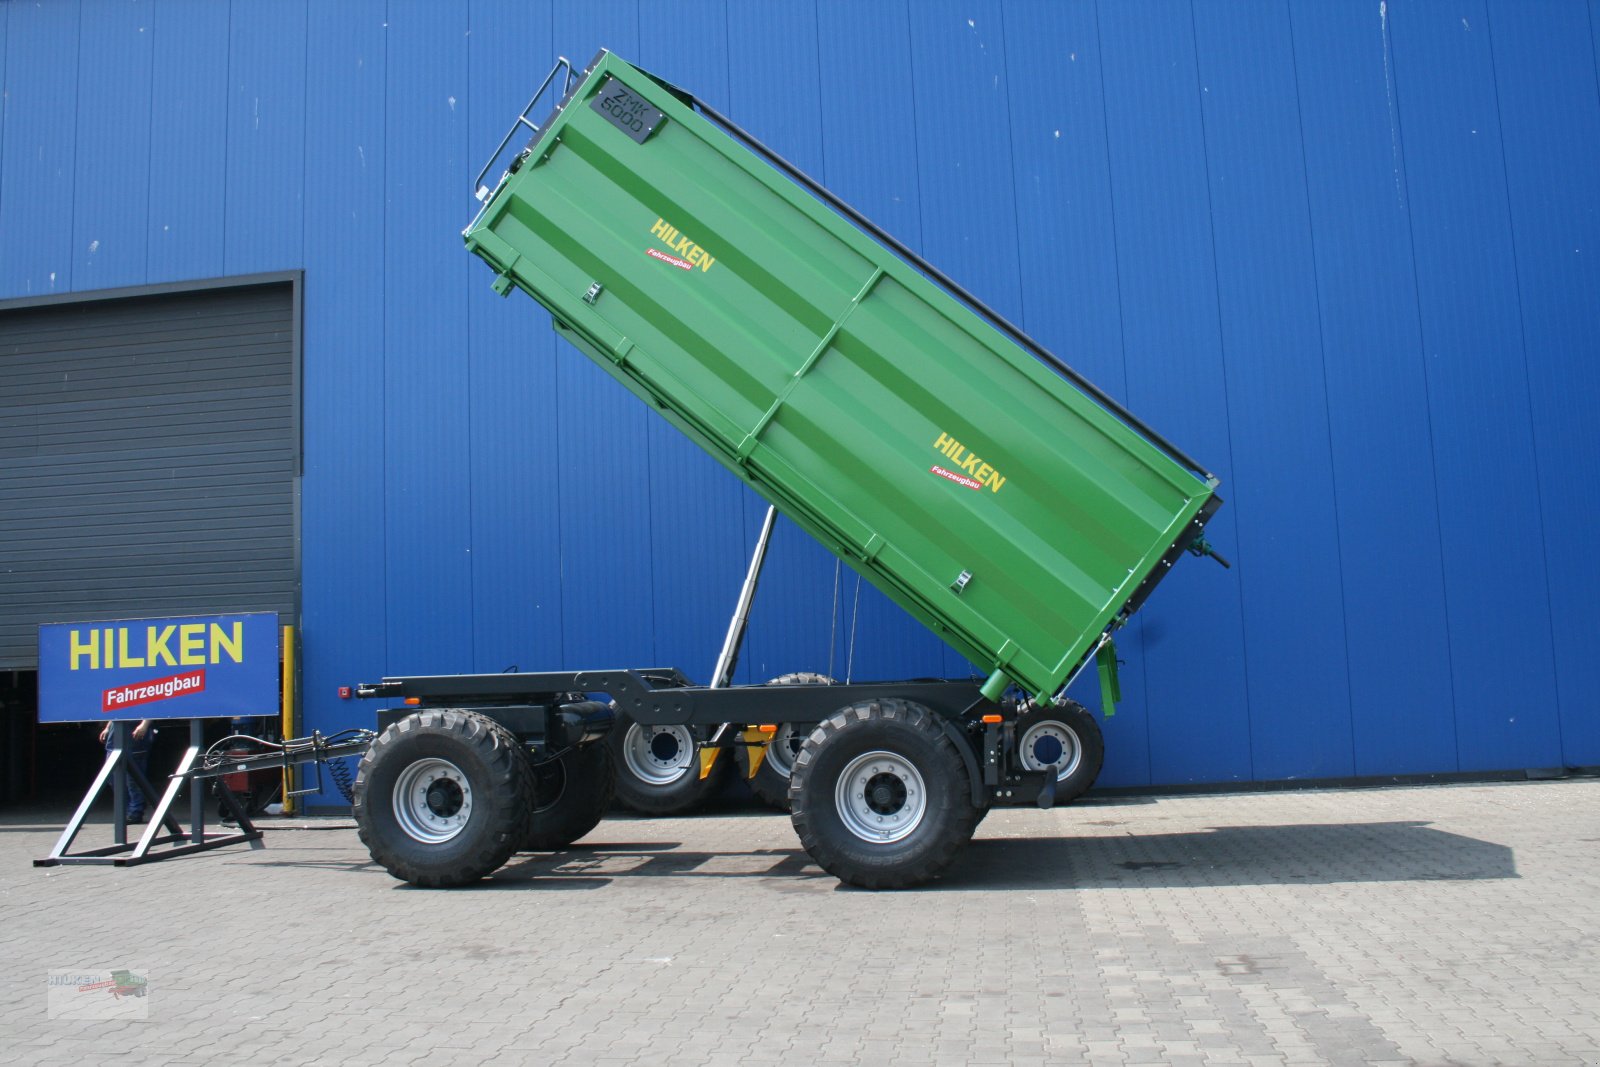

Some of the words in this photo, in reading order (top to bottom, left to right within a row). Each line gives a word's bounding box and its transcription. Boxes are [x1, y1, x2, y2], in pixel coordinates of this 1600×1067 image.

[600, 97, 644, 133] 5000
[613, 88, 649, 117] ZMK
[647, 248, 692, 270] Fahrzeugbau
[650, 217, 716, 273] HILKEN
[931, 465, 980, 489] Fahrzeugbau
[933, 431, 1006, 493] HILKEN
[70, 621, 243, 670] HILKEN
[107, 675, 201, 706] Fahrzeugbau
